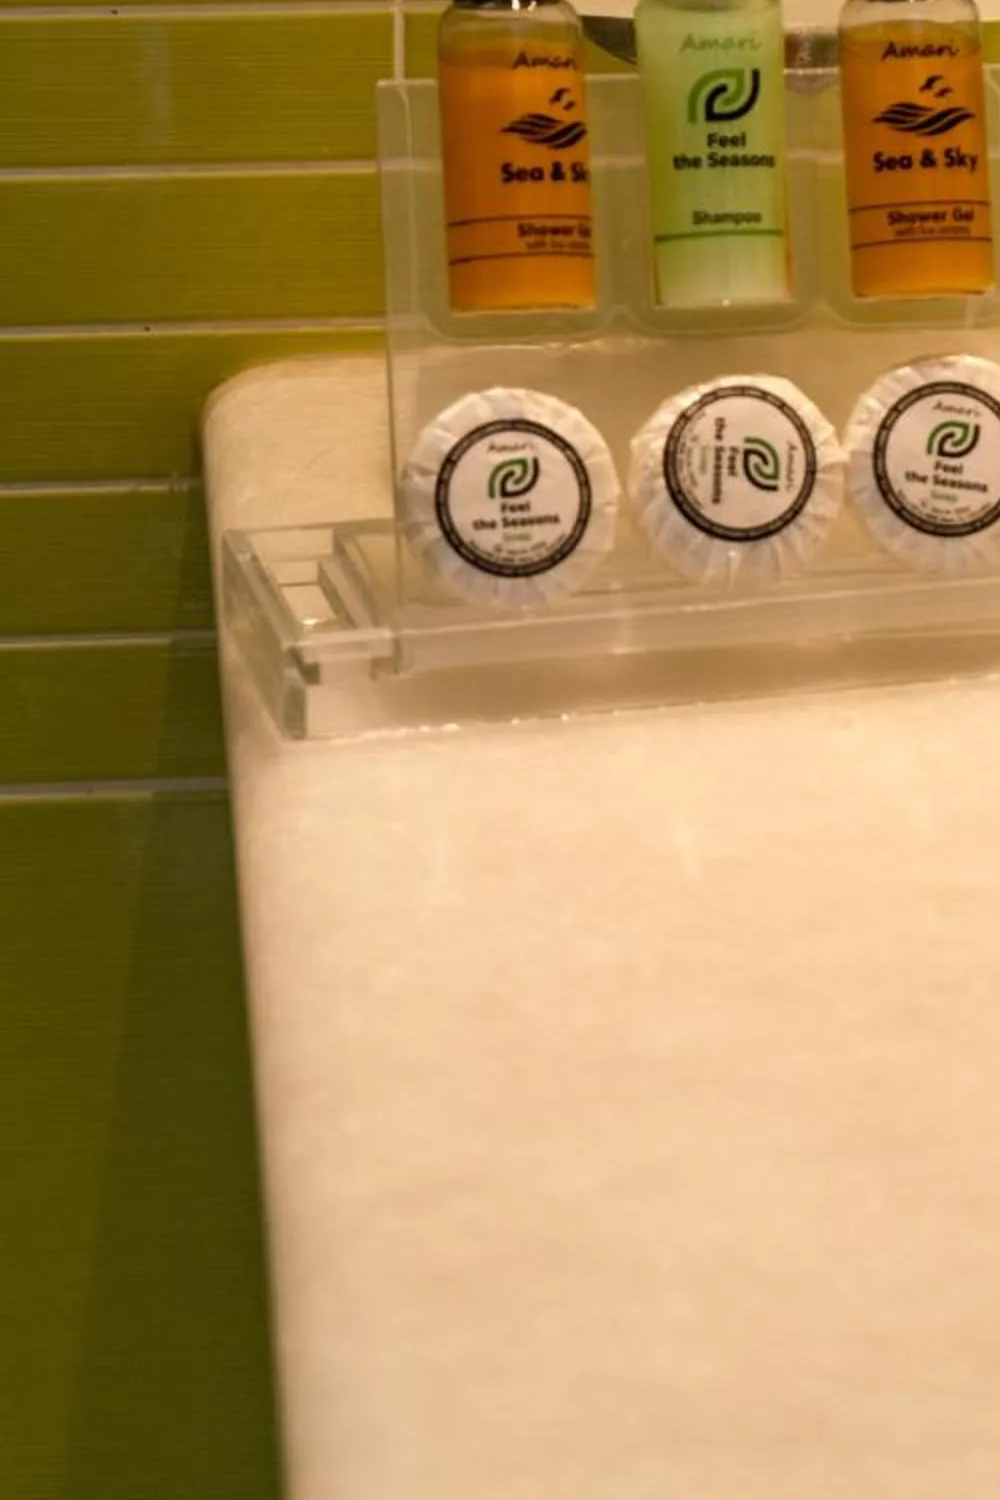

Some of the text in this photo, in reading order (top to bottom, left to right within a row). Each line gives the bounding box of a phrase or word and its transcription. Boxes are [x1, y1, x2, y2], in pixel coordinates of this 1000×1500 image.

[881, 40, 960, 61] Amari
[706, 131, 747, 148] Feel
[673, 153, 702, 170] the
[873, 147, 978, 173] Sea & Sky
[500, 162, 544, 184] Sea
[550, 160, 566, 182] &
[692, 209, 763, 227] Shampoo
